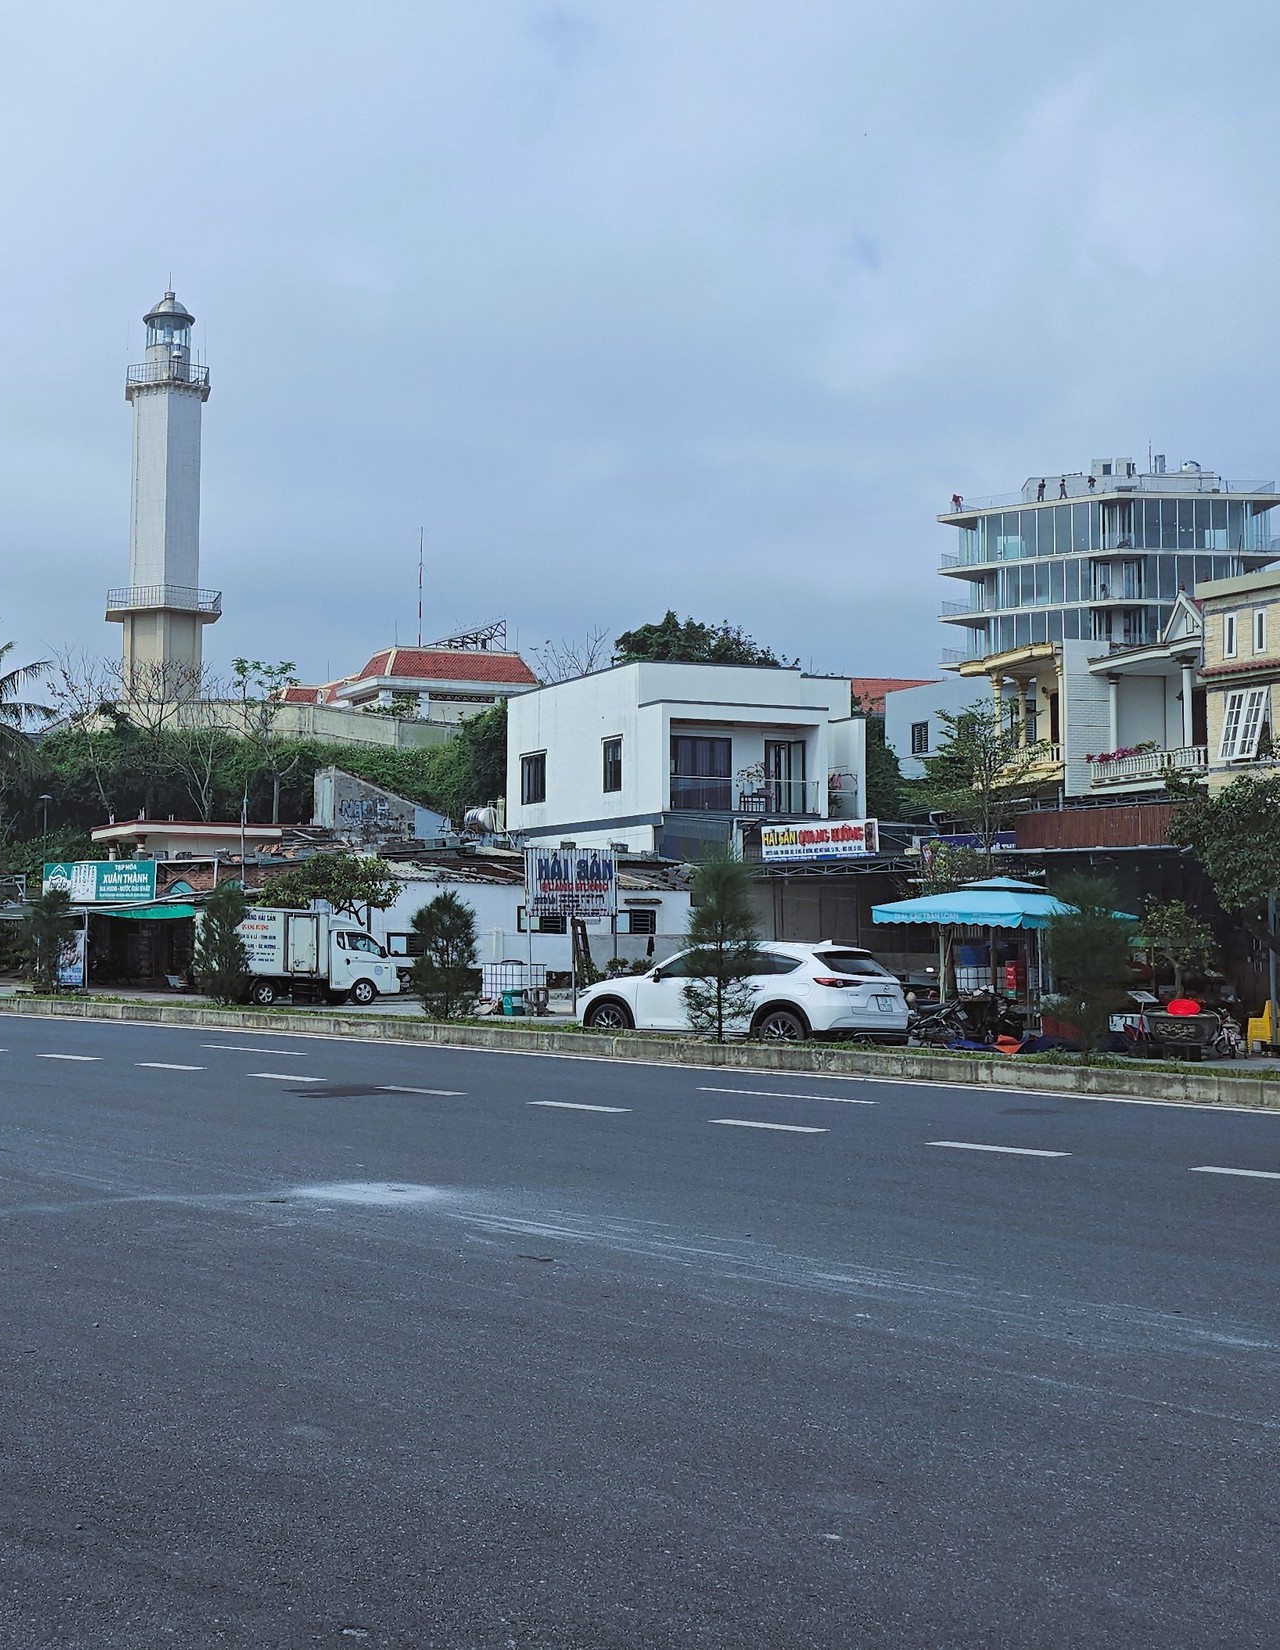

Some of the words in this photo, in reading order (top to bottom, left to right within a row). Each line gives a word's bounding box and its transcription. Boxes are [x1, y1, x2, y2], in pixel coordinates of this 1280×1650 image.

[798, 829, 830, 846] QUANG
[538, 852, 569, 880] HẢI
[577, 852, 613, 880] SẢN
[103, 872, 122, 883] XUÂN
[123, 871, 148, 883] THÀNH
[541, 882, 575, 892] QUANG
